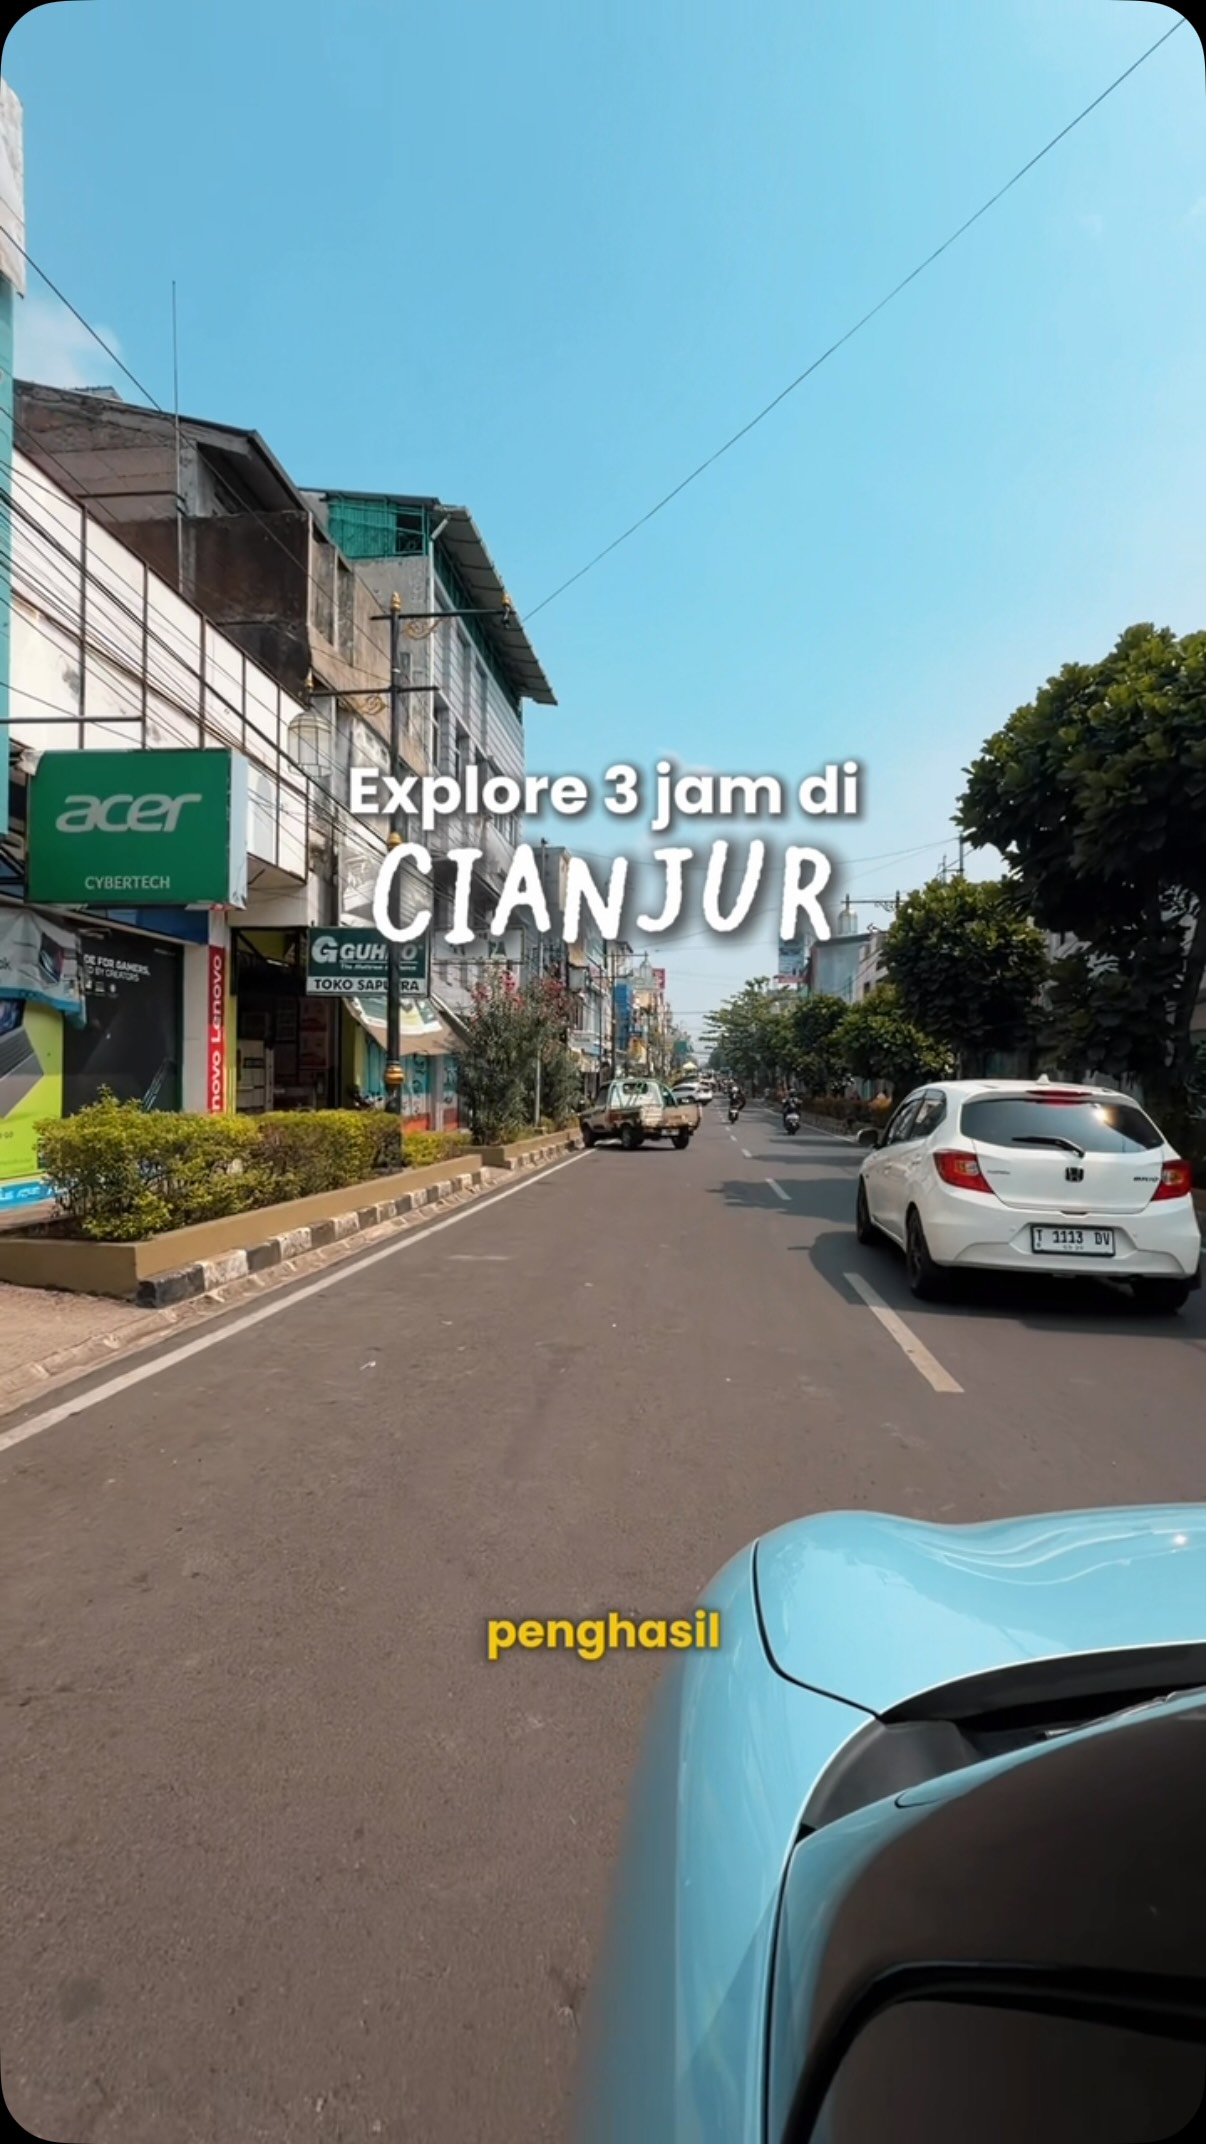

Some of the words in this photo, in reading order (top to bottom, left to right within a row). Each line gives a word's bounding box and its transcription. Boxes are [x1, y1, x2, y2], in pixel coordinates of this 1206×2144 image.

[55, 793, 203, 833] acer
[84, 875, 171, 890] CYBERTECH
[340, 943, 418, 960] GUHO
[314, 979, 354, 991] TOKO
[357, 979, 420, 991] SAPURA
[211, 955, 222, 1043] Lenovo
[211, 1052, 222, 1111] novo
[1035, 1229, 1043, 1243] T
[1052, 1230, 1084, 1244] 1113
[1093, 1231, 1110, 1246] DV
